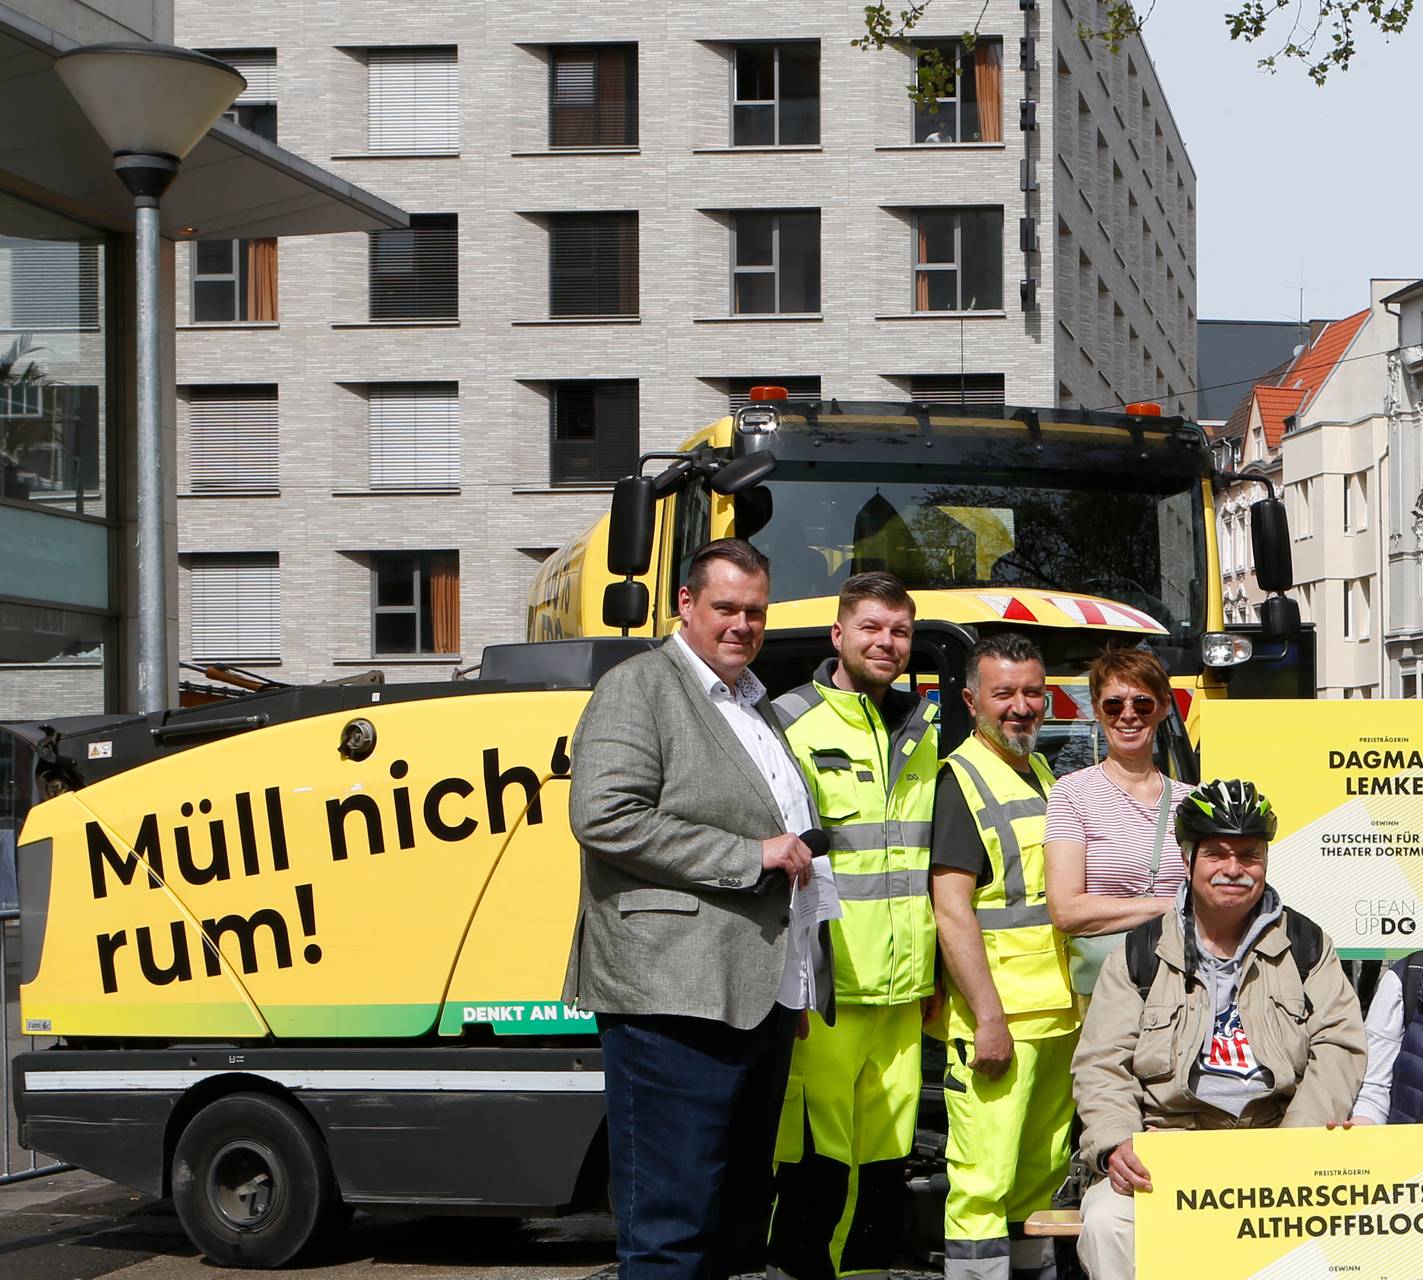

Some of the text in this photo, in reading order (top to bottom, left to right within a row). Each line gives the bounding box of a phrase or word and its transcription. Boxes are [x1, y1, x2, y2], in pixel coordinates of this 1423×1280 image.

[1346, 777, 1423, 795] LEMKE
[85, 786, 290, 899] Müll
[1321, 834, 1393, 844] GUTSCHEIN
[1396, 831, 1420, 844] FÜR
[1320, 847, 1372, 857] THEATER
[1354, 899, 1415, 916] CLEAN
[96, 883, 323, 994] rum!
[463, 1006, 525, 1022] DENKT
[529, 1006, 558, 1021] AN
[1314, 1168, 1371, 1176] PREISTRÄGERIN
